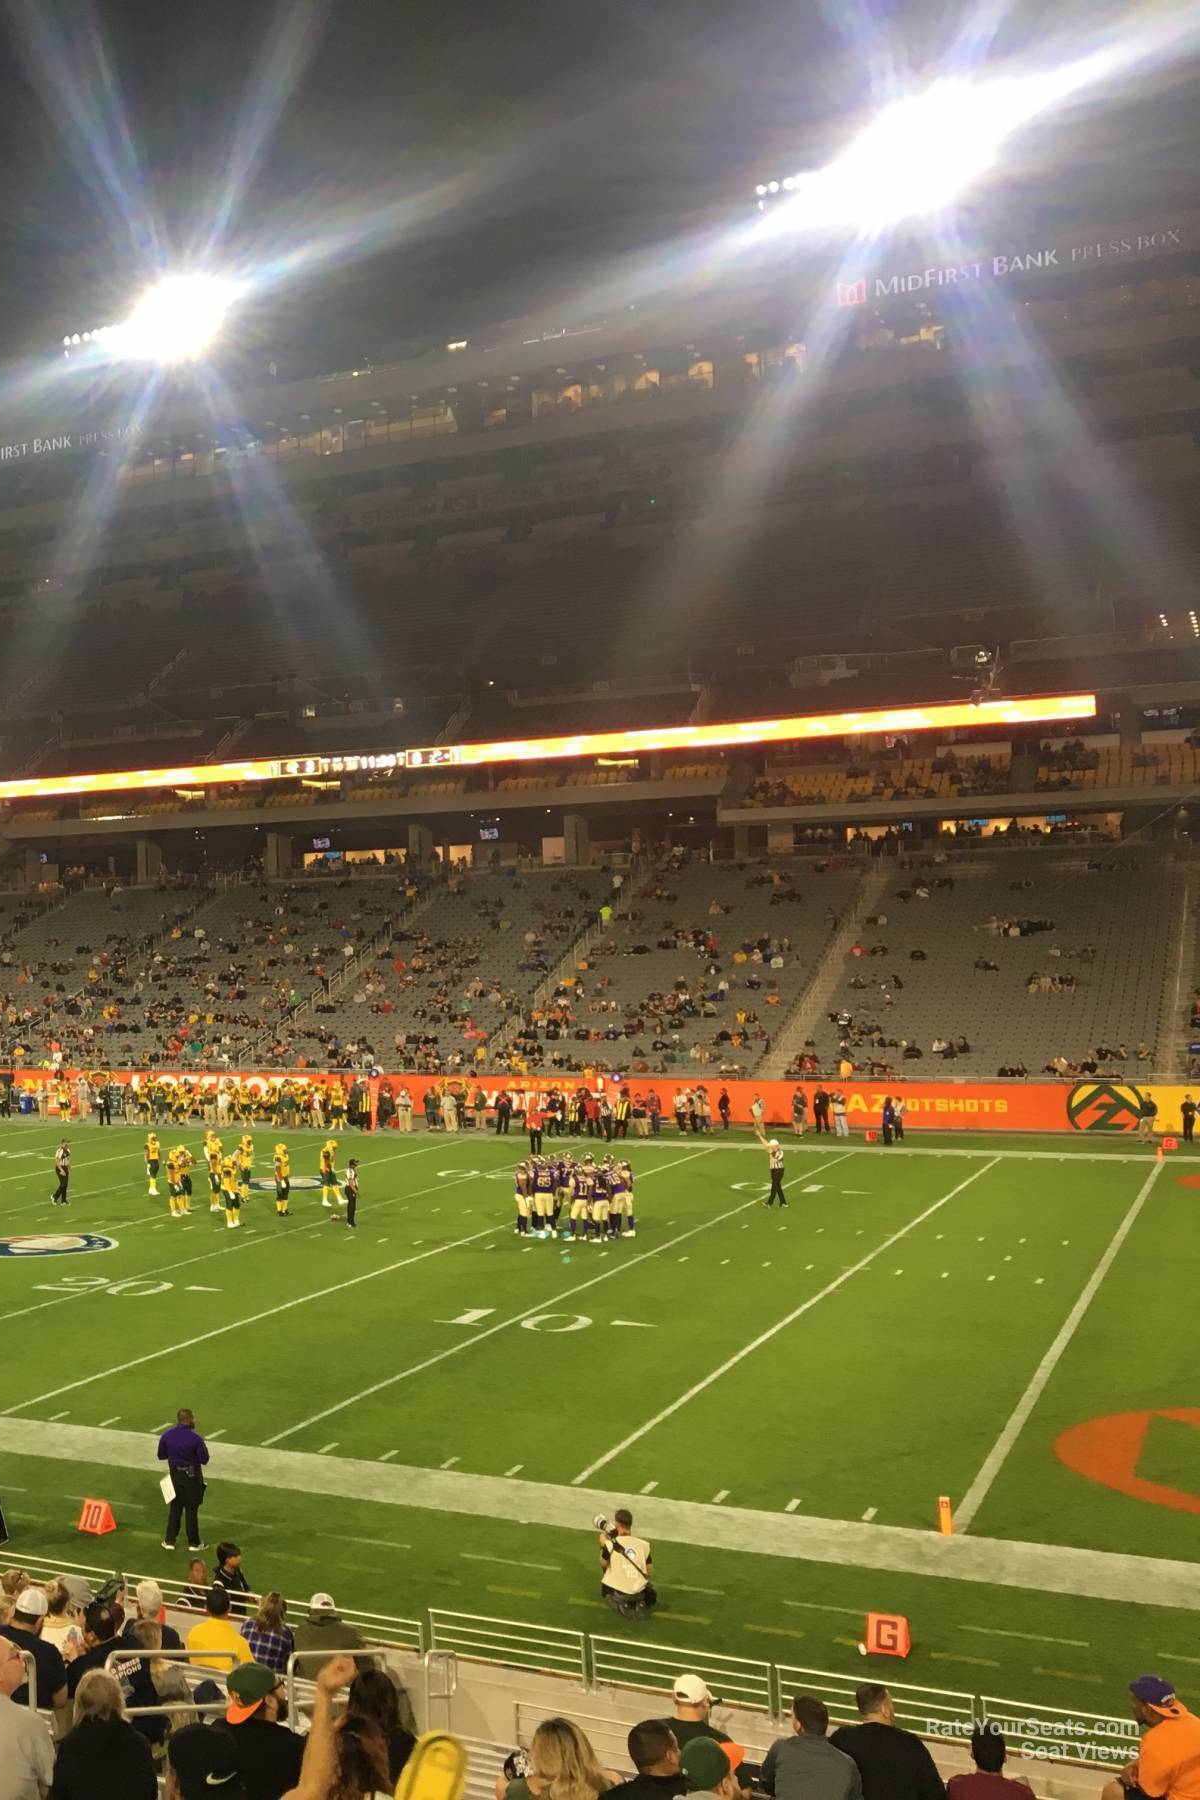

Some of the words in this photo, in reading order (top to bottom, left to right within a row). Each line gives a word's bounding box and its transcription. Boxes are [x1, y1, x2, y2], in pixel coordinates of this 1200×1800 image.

[1071, 239, 1131, 262] PRESS
[1138, 229, 1181, 250] BOX
[903, 1098, 1009, 1113] OTSHOTS
[32, 1276, 174, 1296] 20
[433, 1308, 594, 1333] 10
[83, 1503, 102, 1528] 10
[876, 1619, 898, 1651] G
